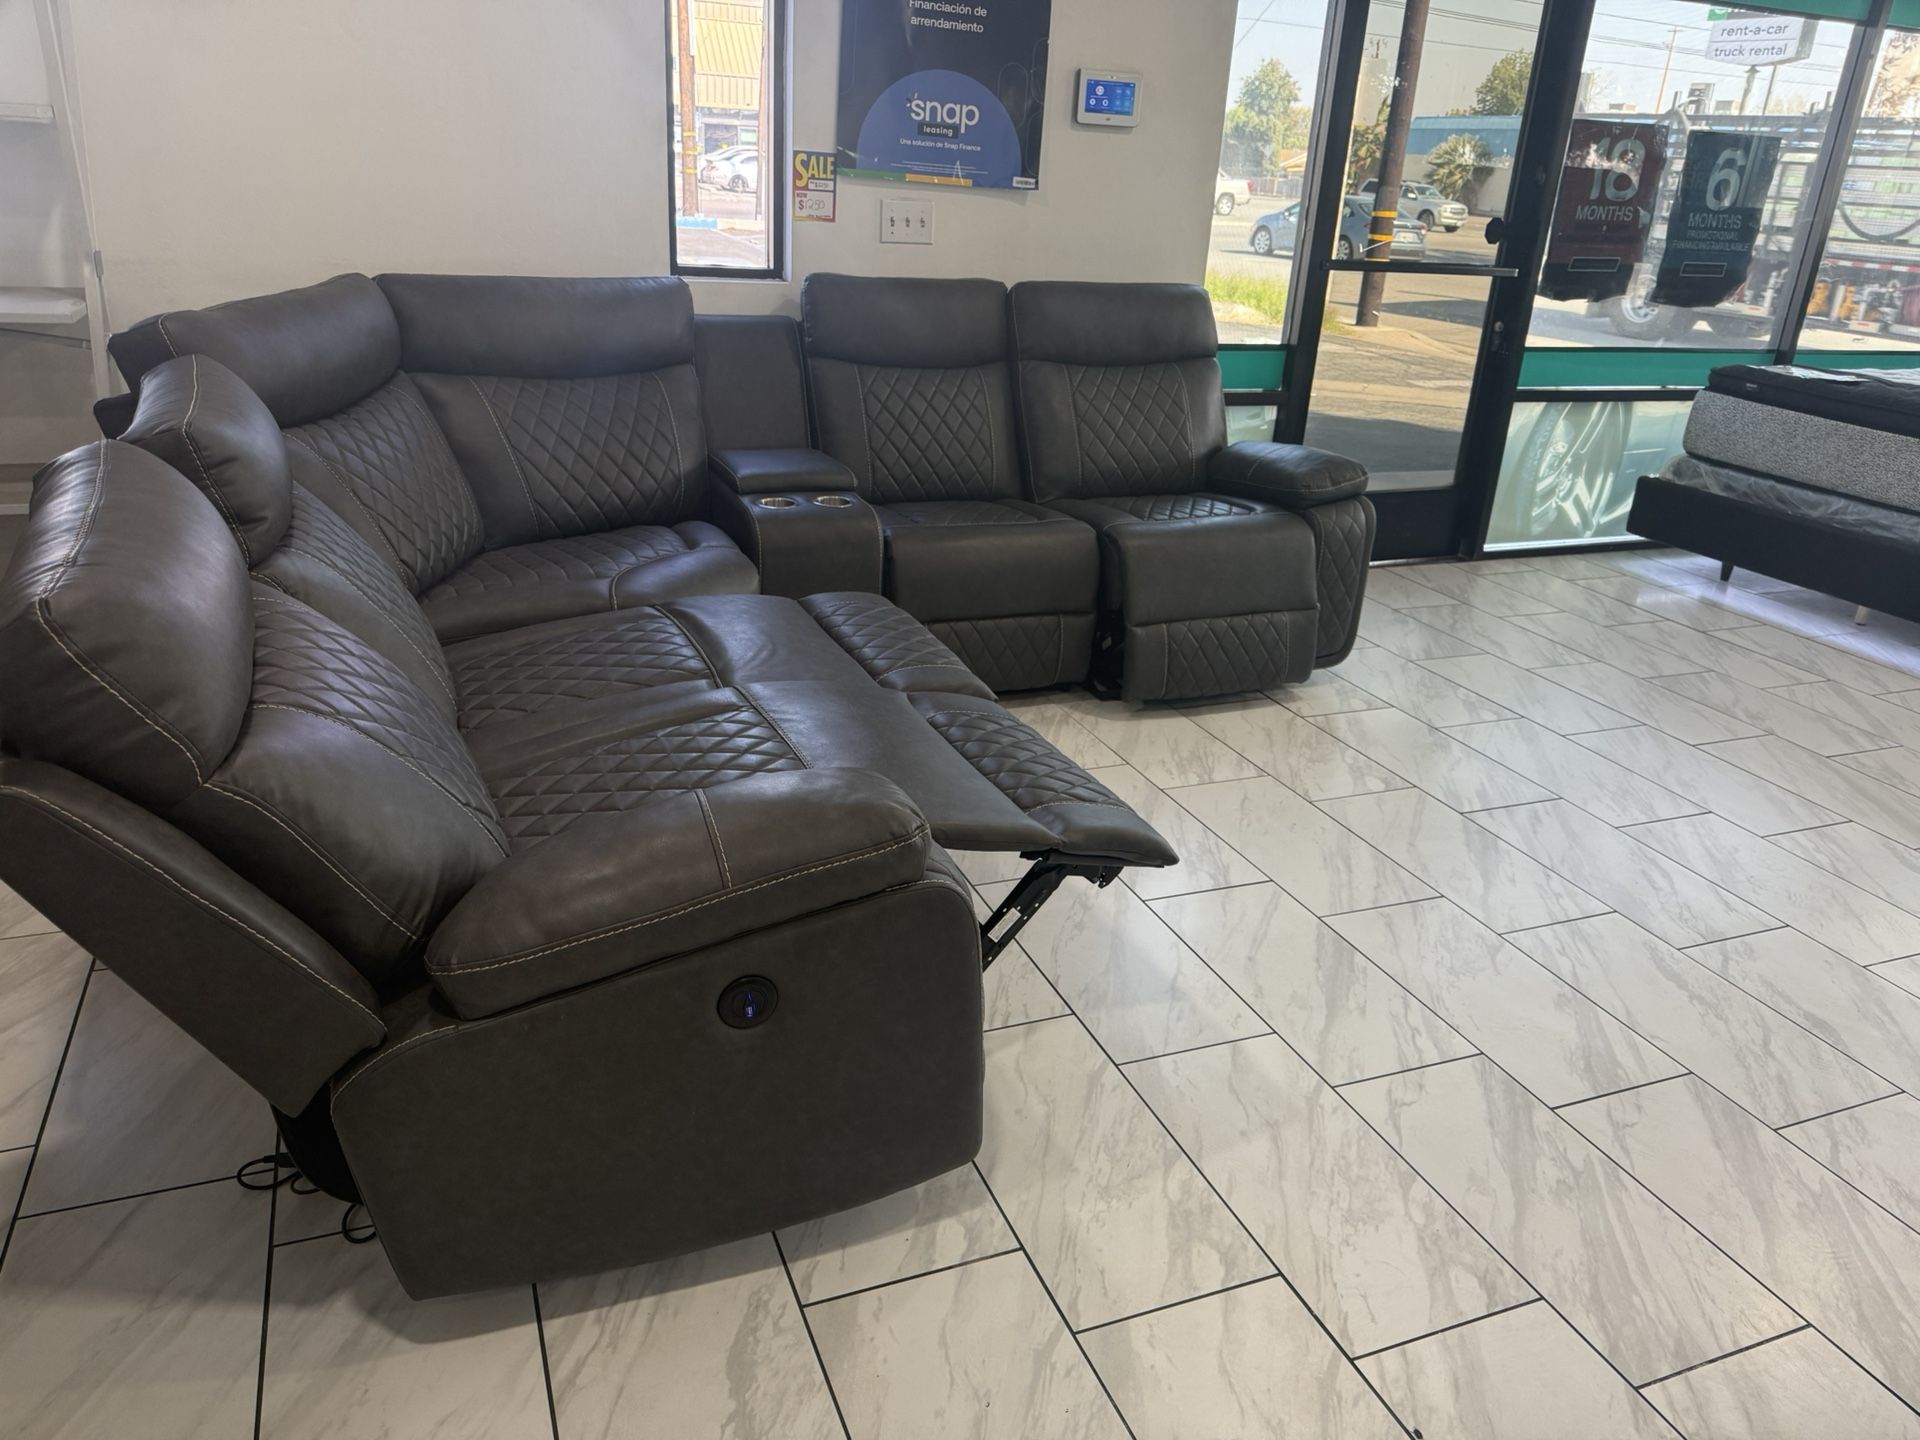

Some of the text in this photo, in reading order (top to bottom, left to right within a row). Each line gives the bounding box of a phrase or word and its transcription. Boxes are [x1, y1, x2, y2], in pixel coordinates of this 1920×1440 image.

[909, 0, 988, 17] Financiación de
[910, 16, 984, 33] arrendamiento
[1721, 23, 1789, 37] rent-a-car
[1714, 43, 1788, 57] truck rental
[911, 99, 980, 134] snap
[923, 125, 953, 137] leasing
[795, 152, 835, 188] SALE
[1589, 137, 1646, 202] 18
[1705, 148, 1748, 211] 6
[1576, 205, 1634, 222] MONTHS
[1687, 212, 1742, 230] MONTHS
